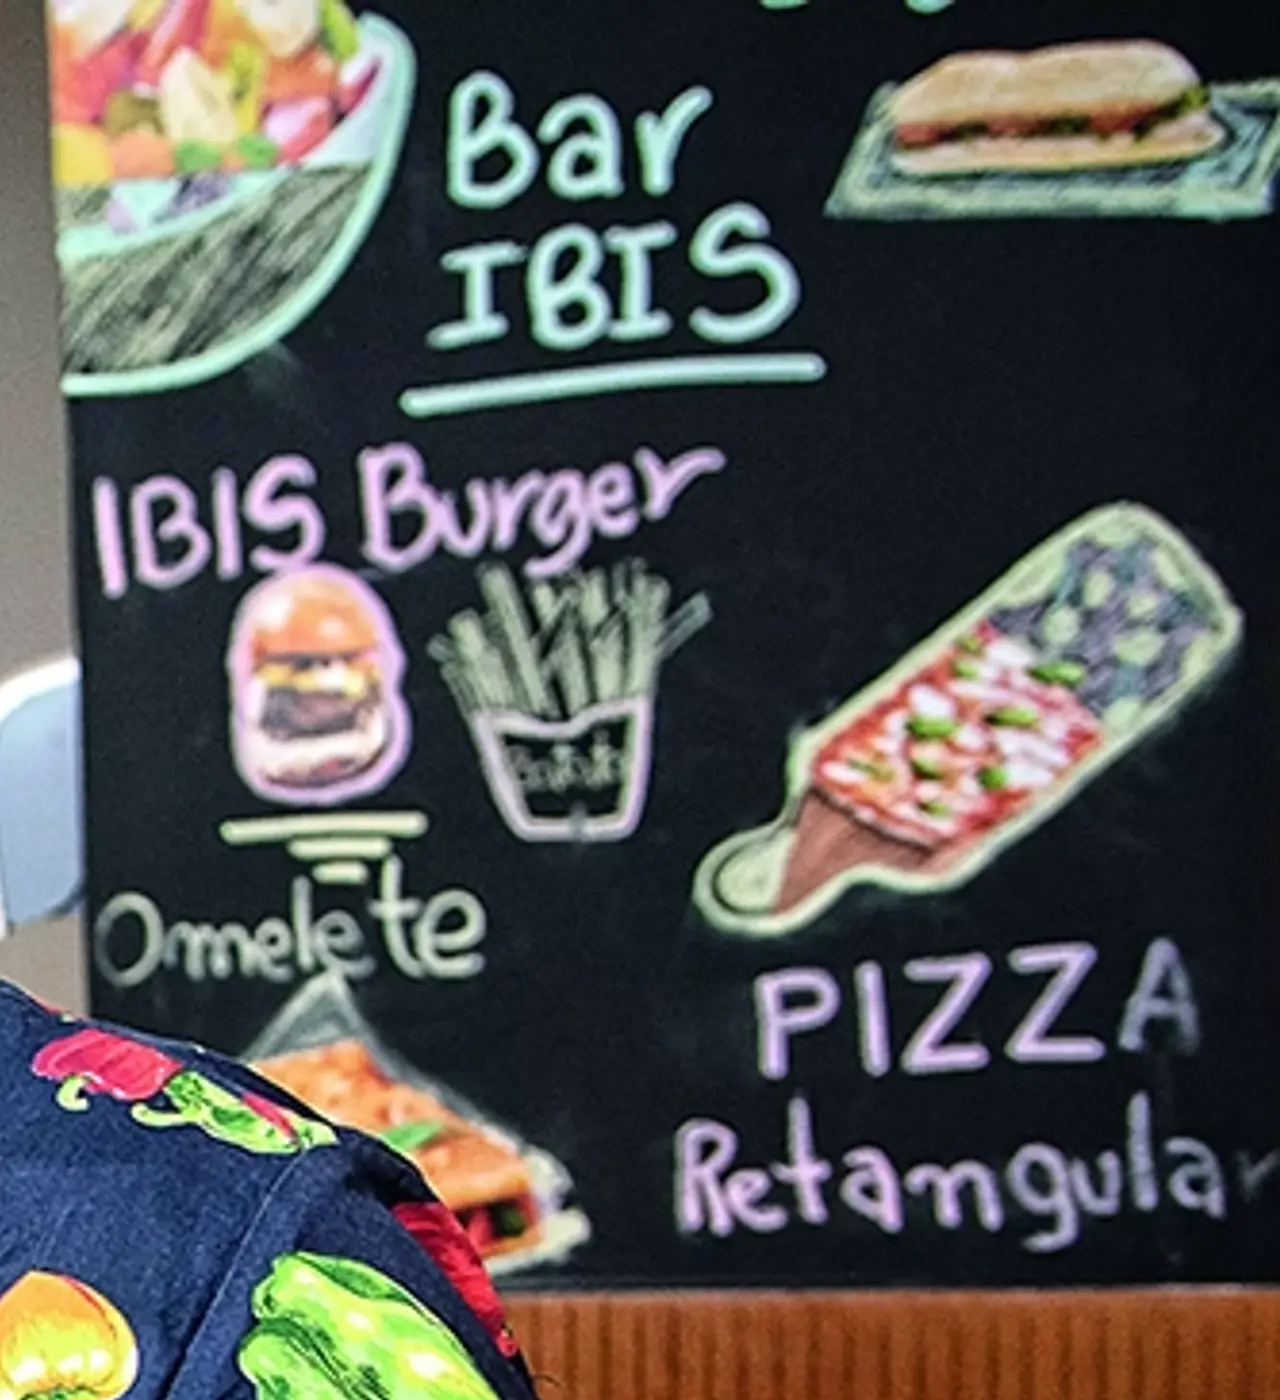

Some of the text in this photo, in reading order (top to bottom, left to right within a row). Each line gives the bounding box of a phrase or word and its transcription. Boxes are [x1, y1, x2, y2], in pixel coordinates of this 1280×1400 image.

[445, 69, 714, 209] Bar
[425, 202, 802, 352] IBIS
[91, 440, 728, 598] IBIS Burger
[94, 852, 487, 988] Omelete
[752, 937, 1198, 1081] PIZZA
